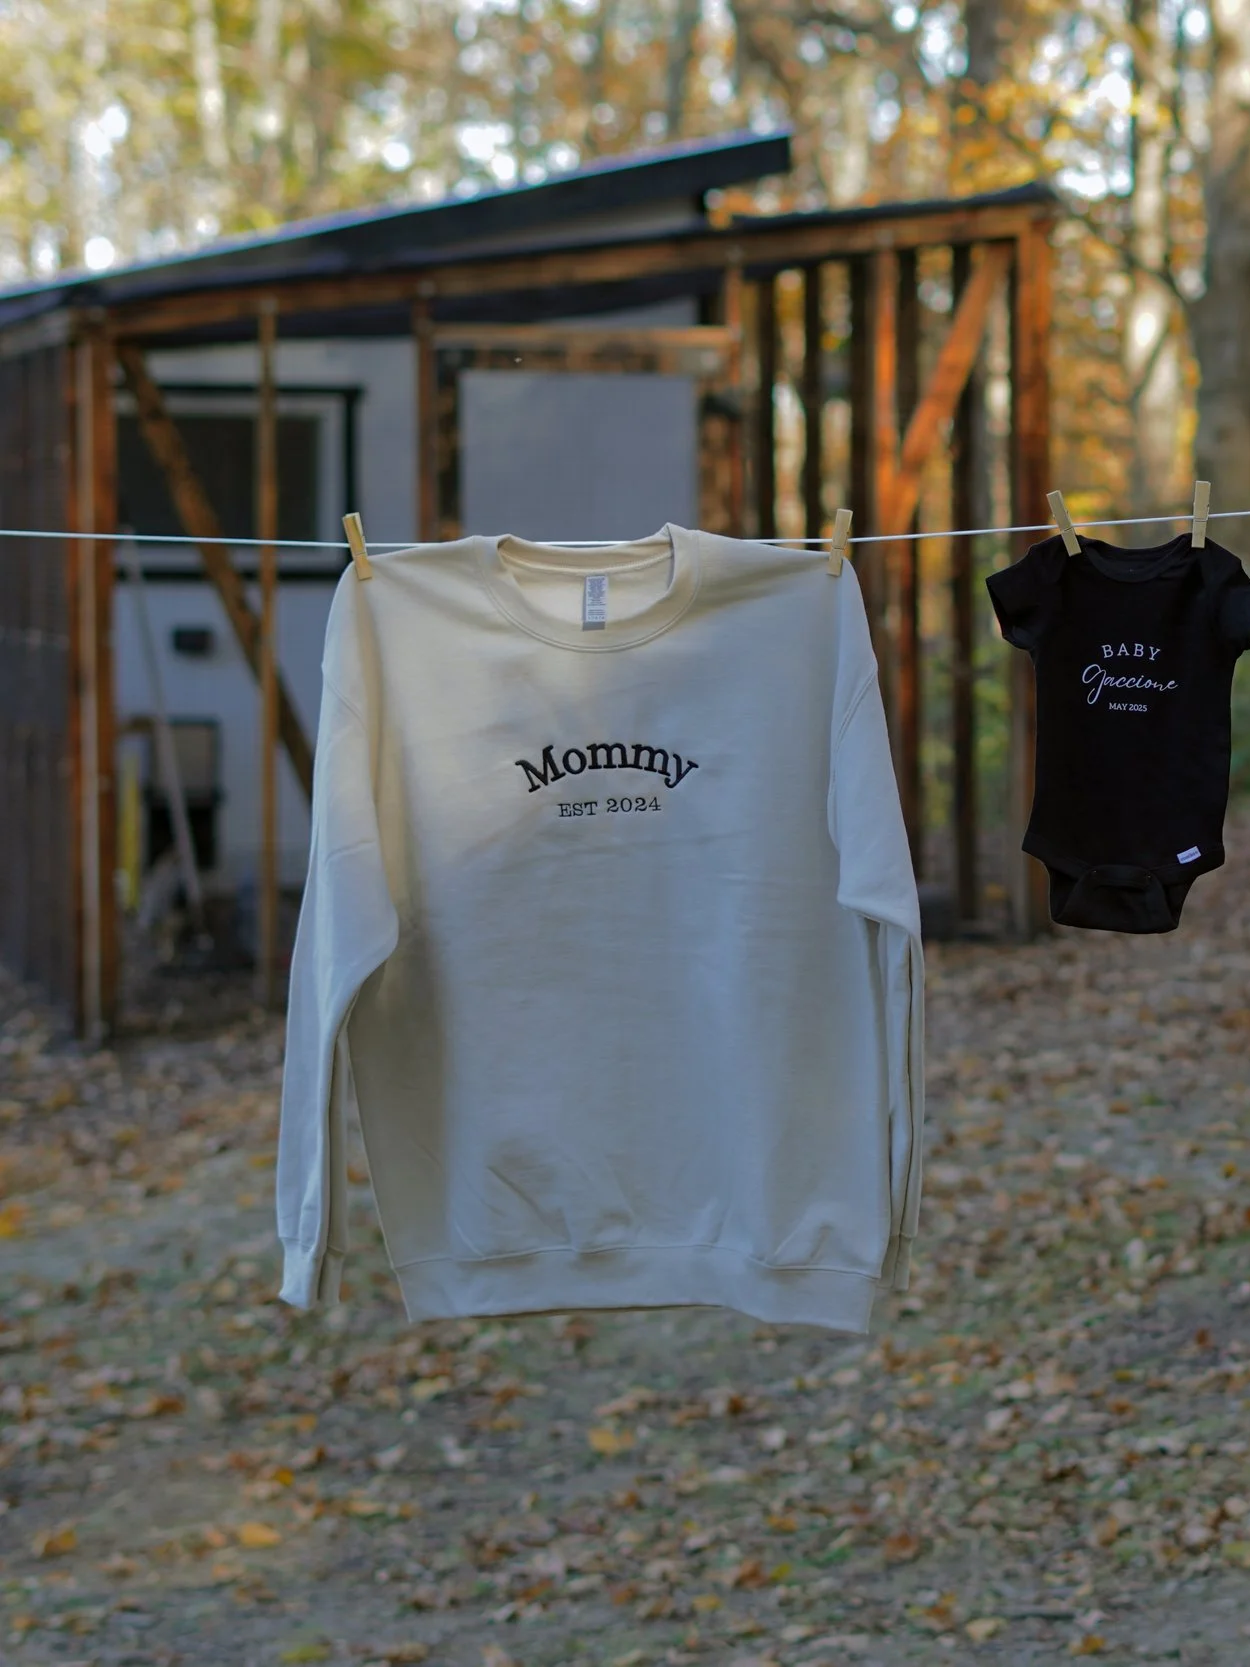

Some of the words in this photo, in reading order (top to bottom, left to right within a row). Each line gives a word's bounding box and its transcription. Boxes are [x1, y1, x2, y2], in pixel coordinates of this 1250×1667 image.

[1101, 643, 1160, 661] BABY
[1108, 702, 1128, 711] MAY
[1128, 703, 1148, 712] 2025
[515, 742, 699, 793] Mommy
[558, 801, 598, 818] EST
[606, 797, 662, 813] 2024
